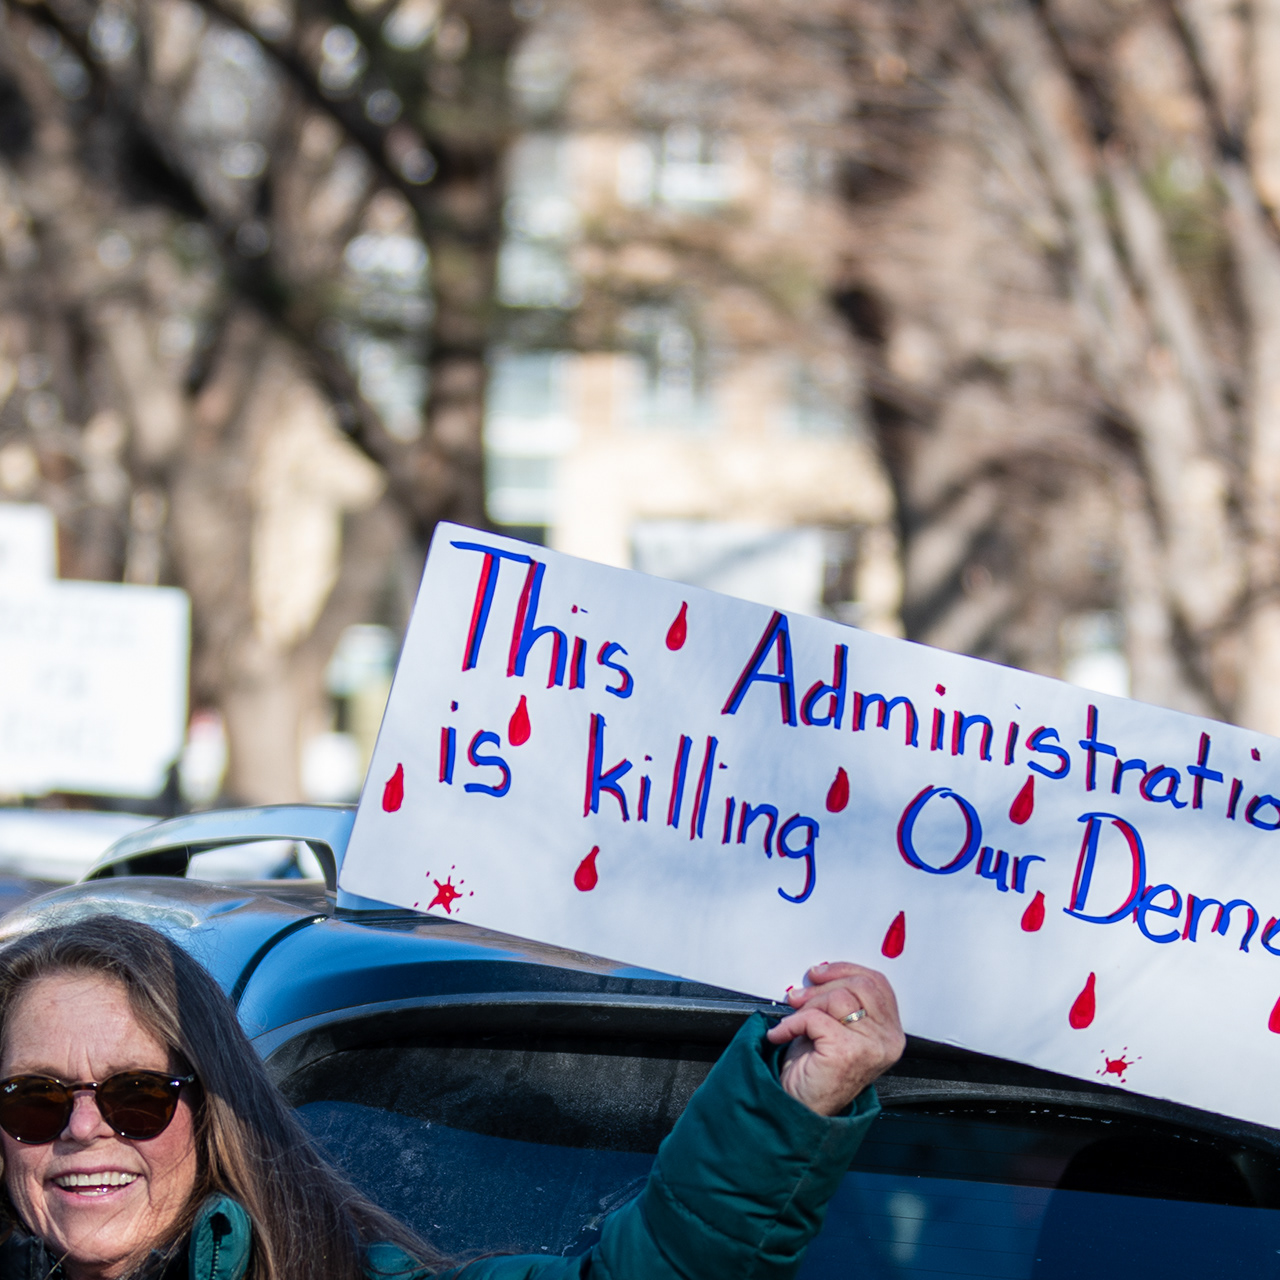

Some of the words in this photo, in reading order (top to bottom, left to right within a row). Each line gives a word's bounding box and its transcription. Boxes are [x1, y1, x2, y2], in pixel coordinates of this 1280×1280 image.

[450, 541, 634, 700] This
[438, 700, 512, 798] is
[583, 712, 820, 904] killing
[897, 784, 1045, 893] Our
